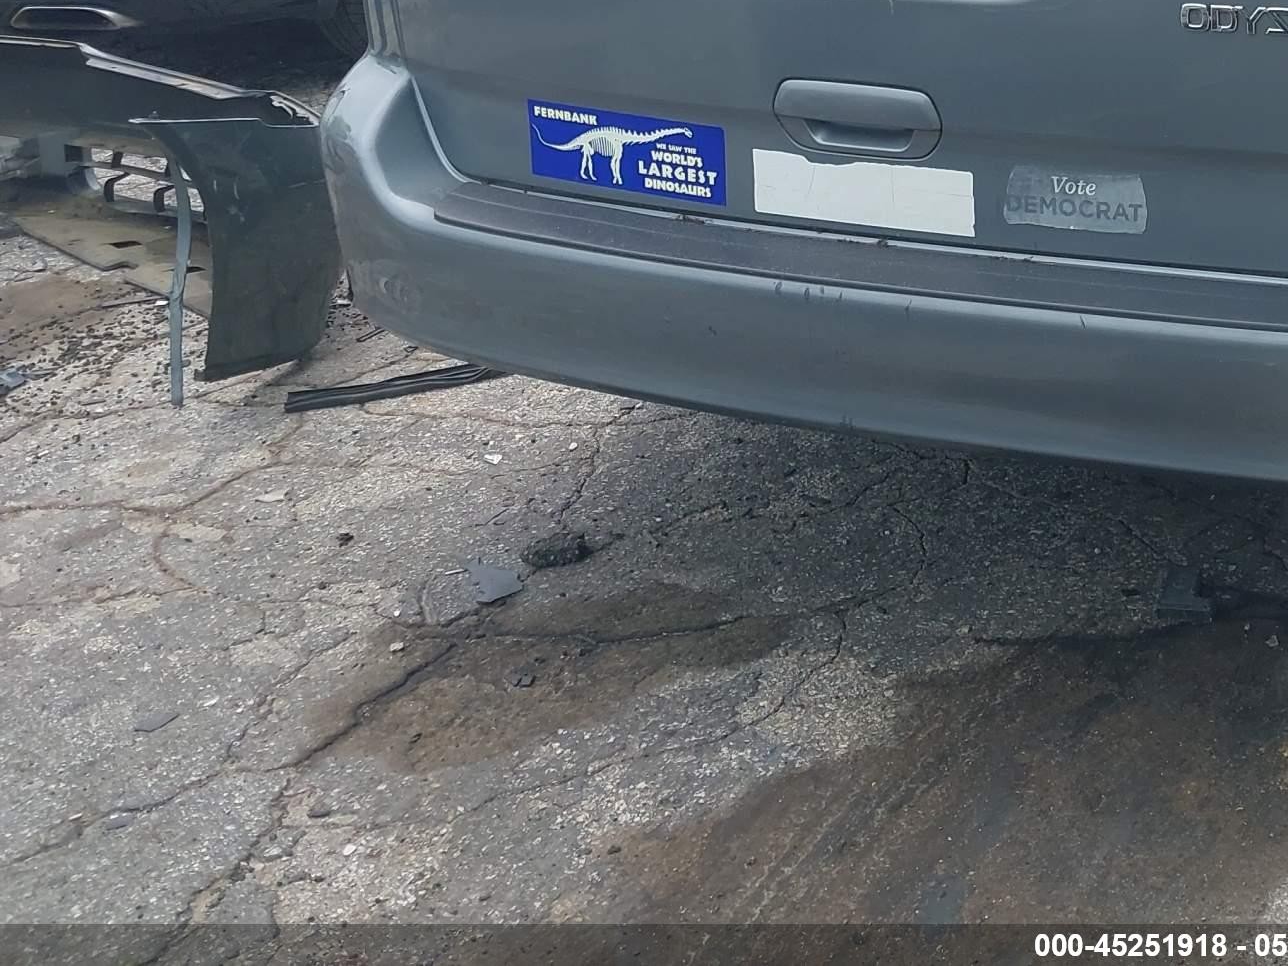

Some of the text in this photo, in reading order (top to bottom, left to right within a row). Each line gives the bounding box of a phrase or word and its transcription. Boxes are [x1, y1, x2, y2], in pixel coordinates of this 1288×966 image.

[533, 105, 598, 125] FERNBANK
[651, 150, 703, 168] WORLD'S
[656, 143, 697, 154] WE SAW THE
[638, 160, 718, 186] LARGEST
[645, 177, 712, 198] DINOSAURS
[1051, 175, 1097, 196] Vote
[1006, 194, 1144, 222] DEMOCRAT
